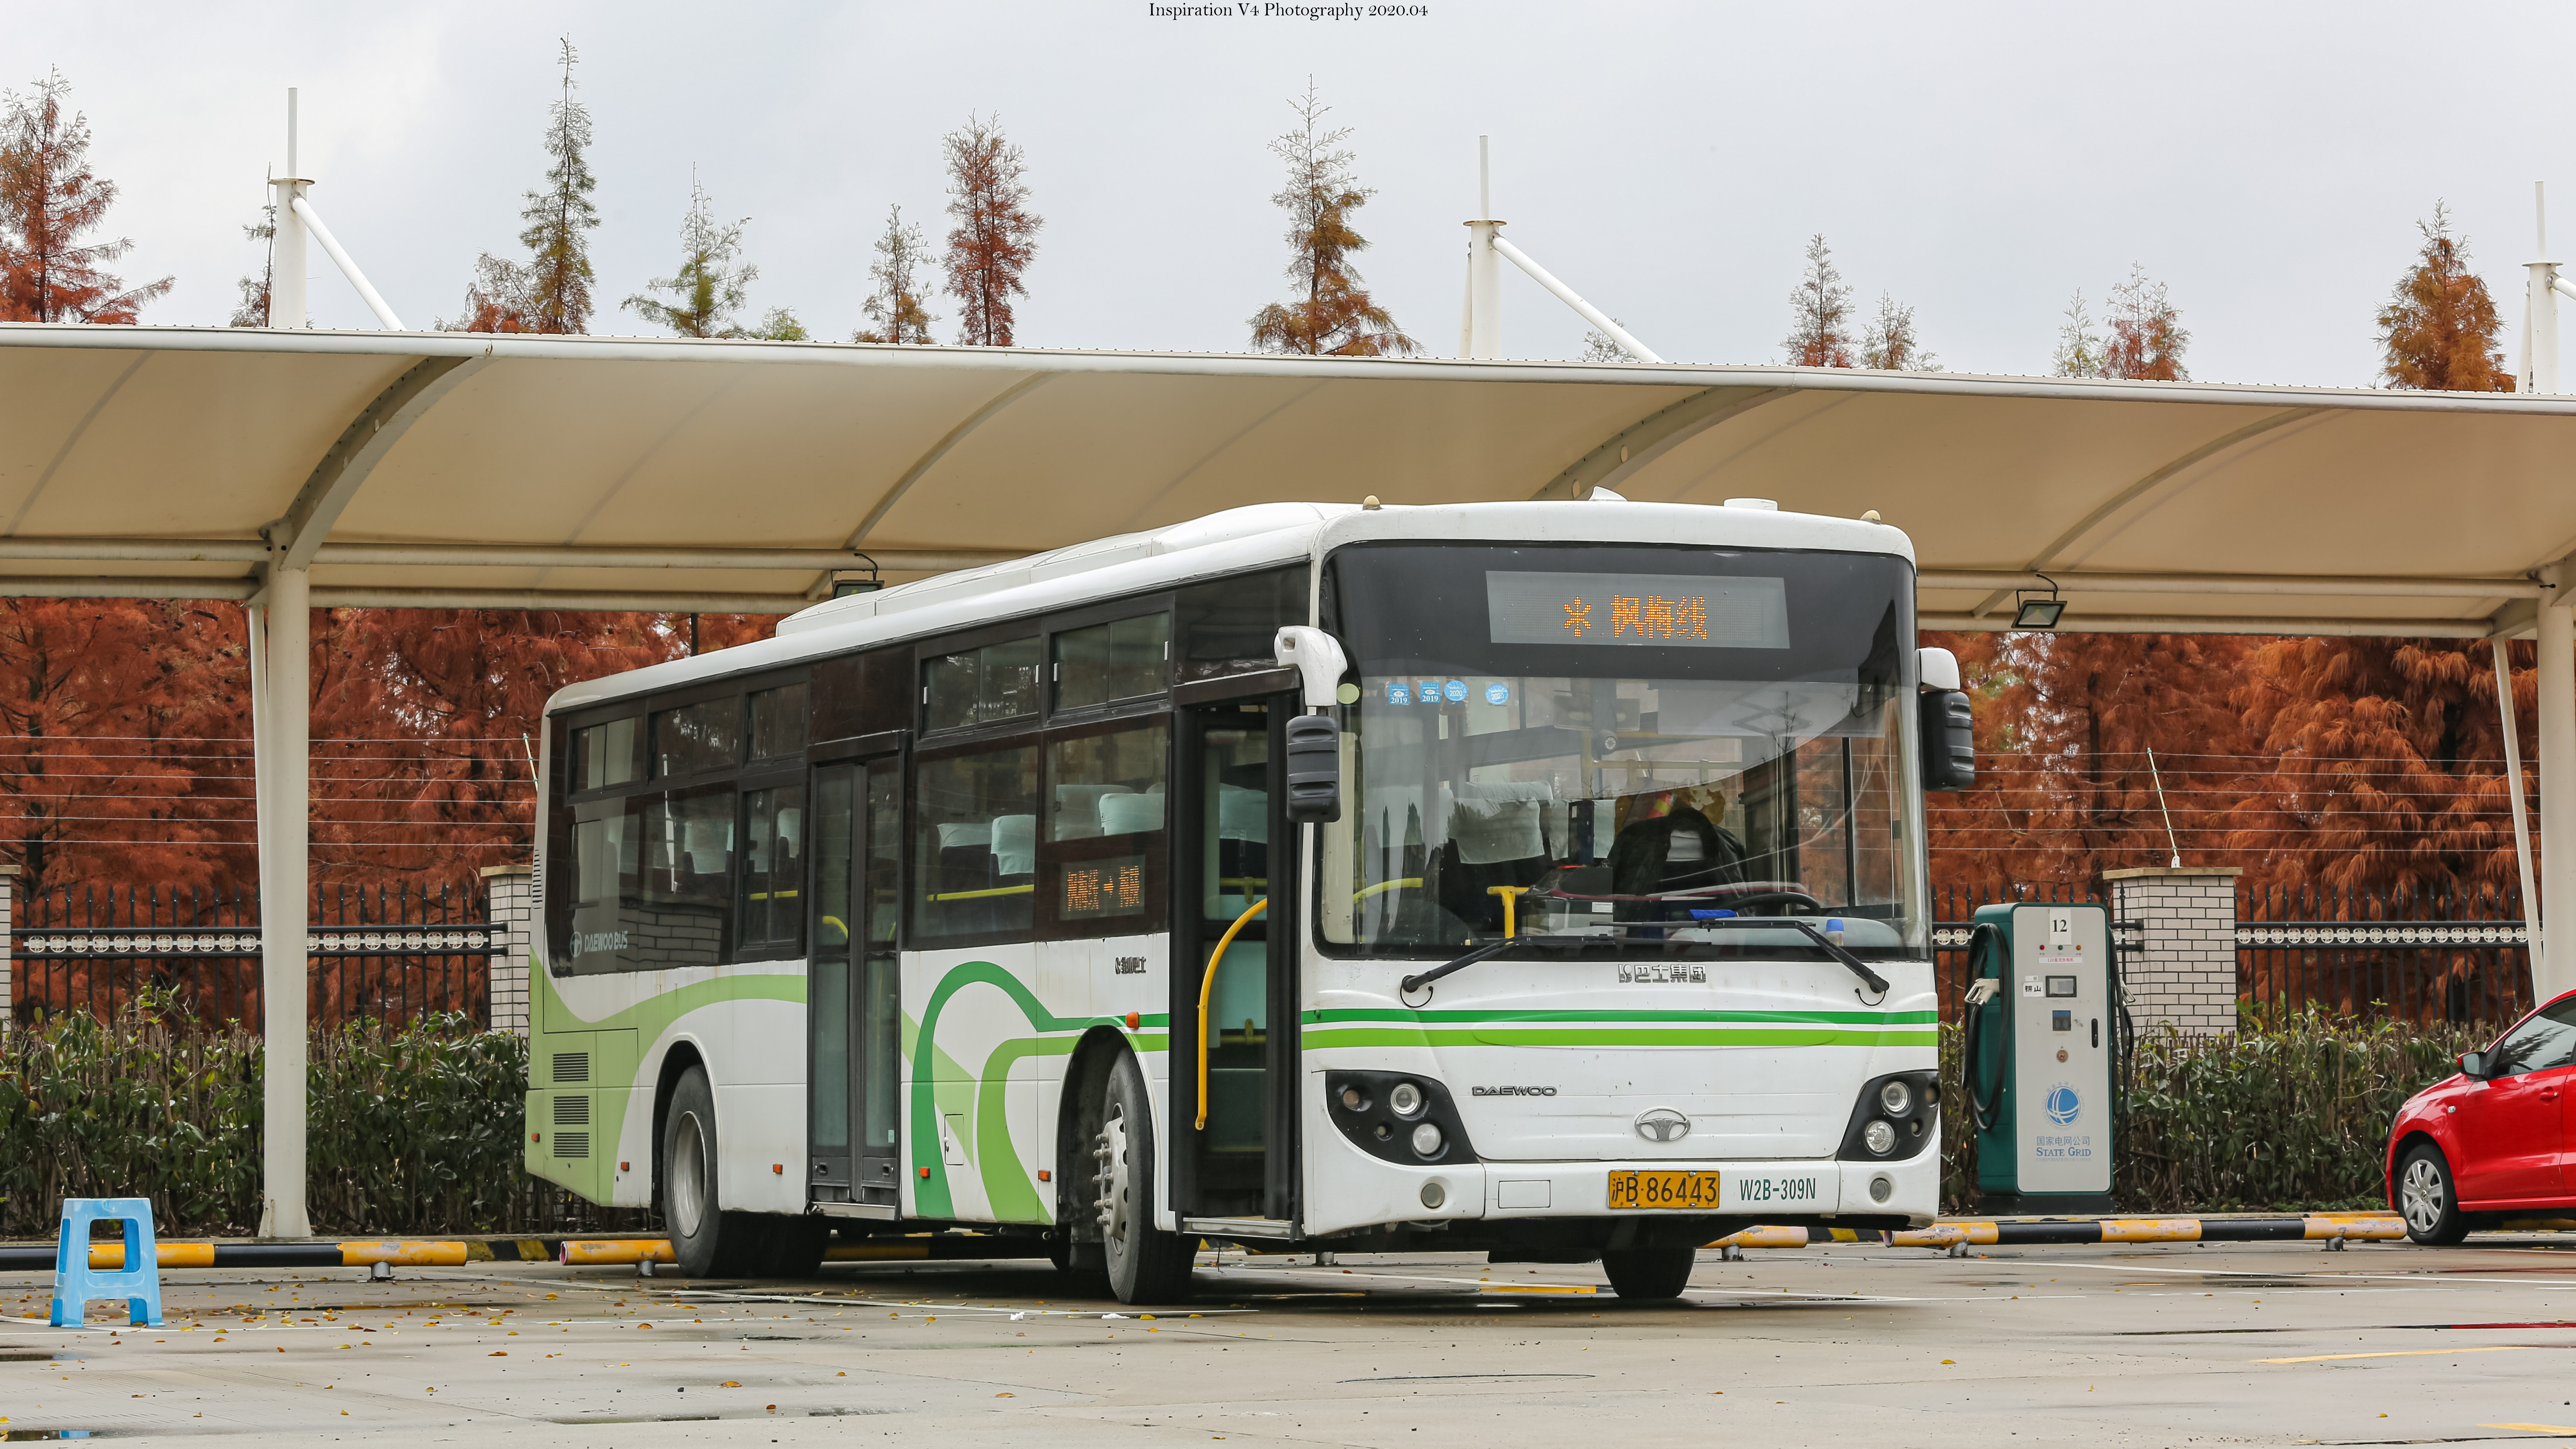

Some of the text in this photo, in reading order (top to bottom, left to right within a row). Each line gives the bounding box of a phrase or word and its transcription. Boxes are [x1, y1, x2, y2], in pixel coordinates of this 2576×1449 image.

[1610, 594, 1707, 640] 枫梅线
[1067, 869, 1099, 911] 枫梅线
[2052, 919, 2068, 932] 12
[585, 930, 628, 952] DAEWOO BUS
[1634, 964, 1706, 983] 巴士集团
[1472, 1086, 1557, 1096] DAEWOO
[2037, 1136, 2090, 1146] 国家电网公司
[2036, 1147, 2091, 1157] STATE GRID
[1740, 1178, 1816, 1201] W2B-309N
